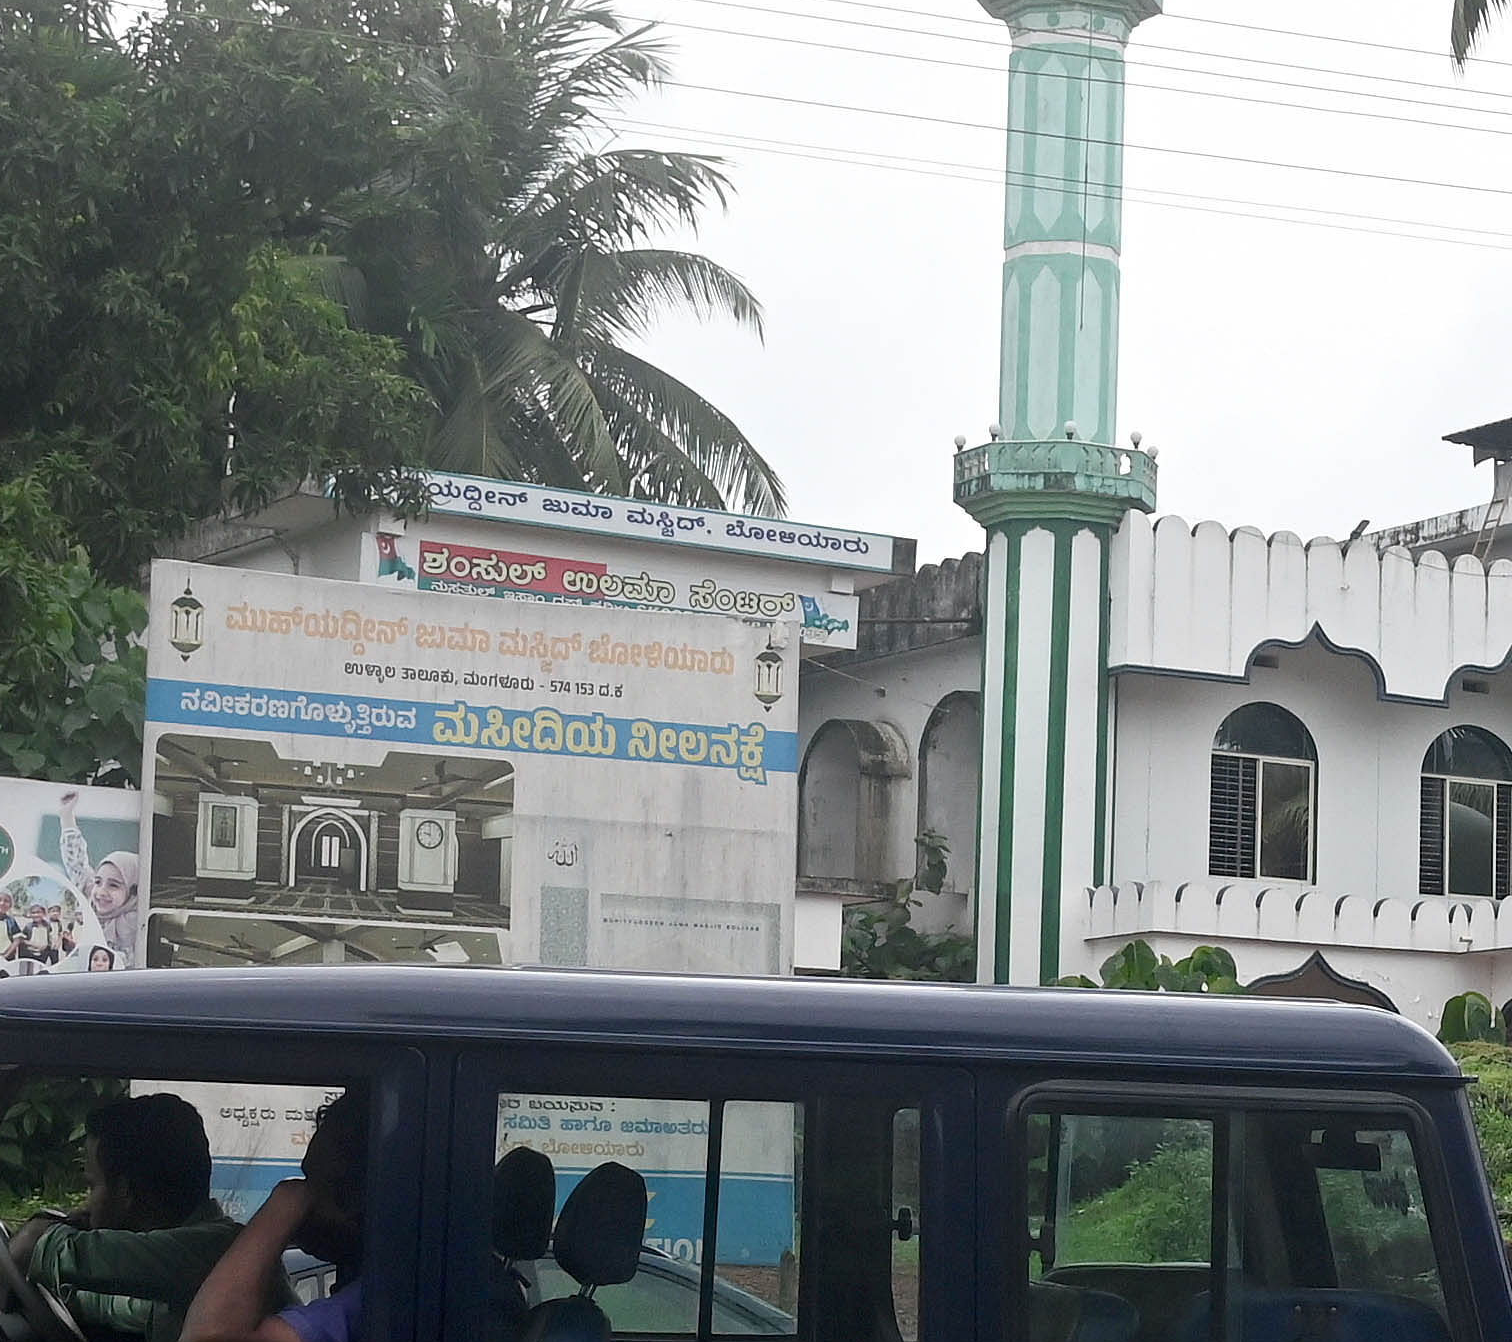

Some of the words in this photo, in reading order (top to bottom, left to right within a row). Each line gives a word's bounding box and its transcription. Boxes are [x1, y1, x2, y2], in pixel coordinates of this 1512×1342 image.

[541, 495, 613, 521] ಜುಮಾ
[421, 546, 547, 587] ಶಂಸುಲ್
[561, 566, 677, 604] ಉಲಮಾ
[688, 578, 796, 618] ಸೆಂಟರ್
[415, 621, 491, 653] ಜುಮಾ
[463, 670, 535, 691] ಮಂಗಳೂರು
[550, 680, 571, 694] 574
[575, 682, 594, 696] 153
[598, 683, 623, 698] ದ.ಕ
[432, 703, 617, 757] ಮಸೀದಿಯ
[627, 721, 767, 785] ನೀಲನಕ್ಷೆ
[503, 1113, 552, 1131] ಸಮಿತಿ
[559, 1116, 612, 1132] ಹಾಗೂ
